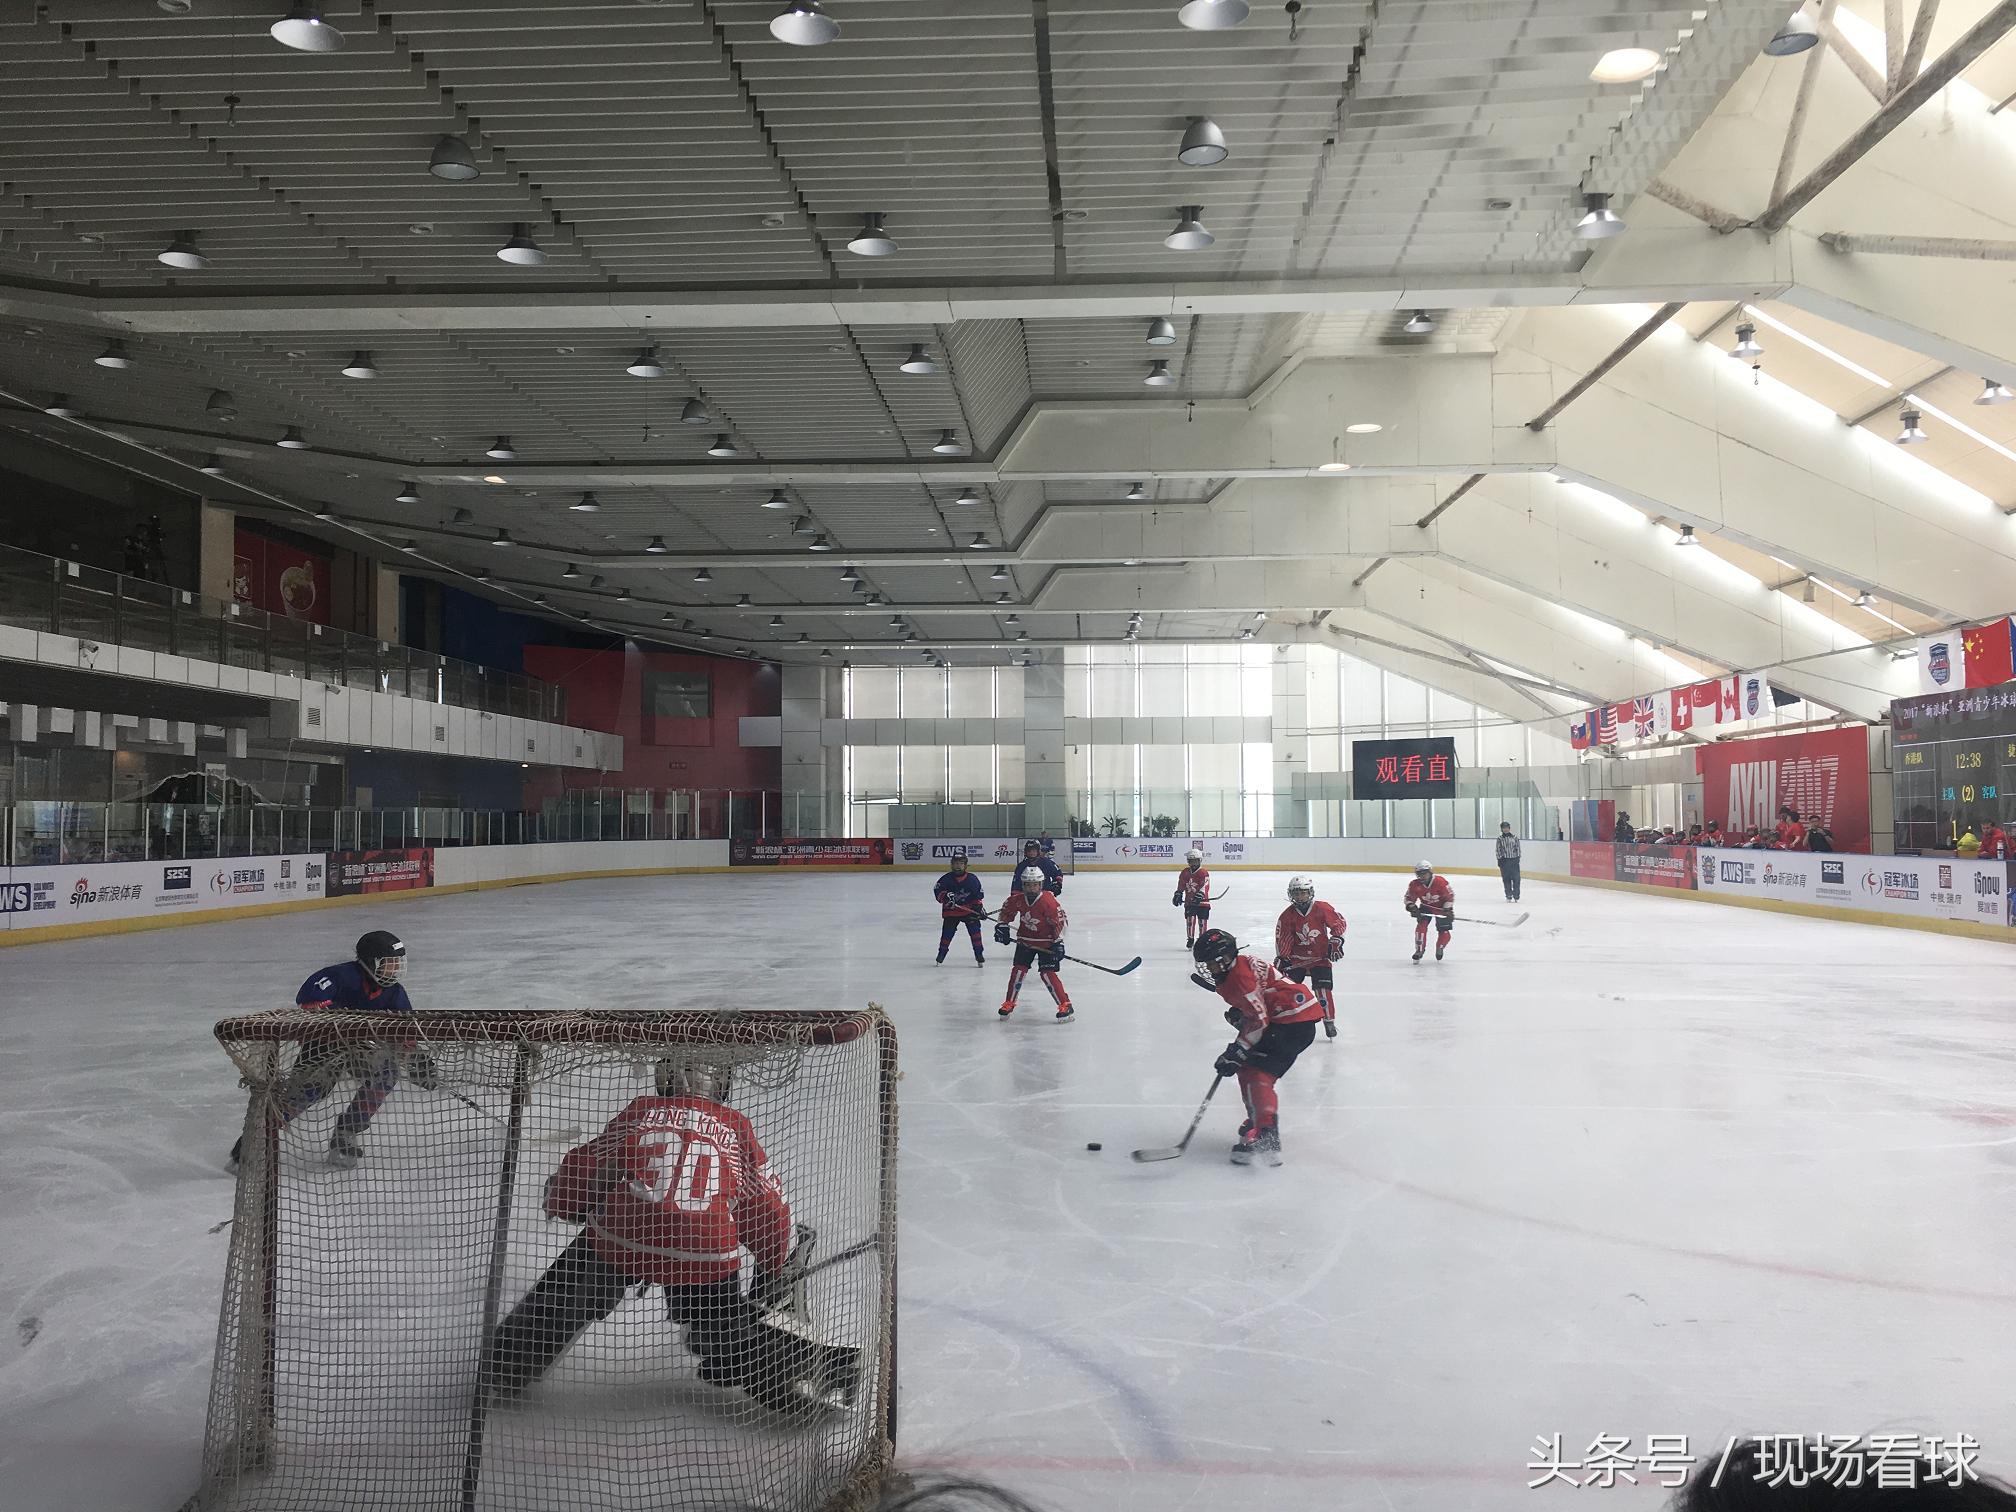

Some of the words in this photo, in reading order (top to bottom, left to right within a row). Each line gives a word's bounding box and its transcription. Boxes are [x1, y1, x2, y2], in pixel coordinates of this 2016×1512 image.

[1375, 754, 1451, 783] 观看直
[1955, 753, 1982, 769] 12:38
[1961, 785, 1975, 802] (2)
[935, 846, 966, 858] AWS
[994, 847, 1015, 858] sina
[1722, 862, 1743, 882] AWS
[1762, 866, 1778, 887] sina
[1884, 871, 1919, 889] 冠军冰场
[97, 884, 143, 903] 新浪体育
[1974, 871, 2000, 897] iSnow
[70, 883, 97, 909] sina
[628, 1130, 720, 1212] 30
